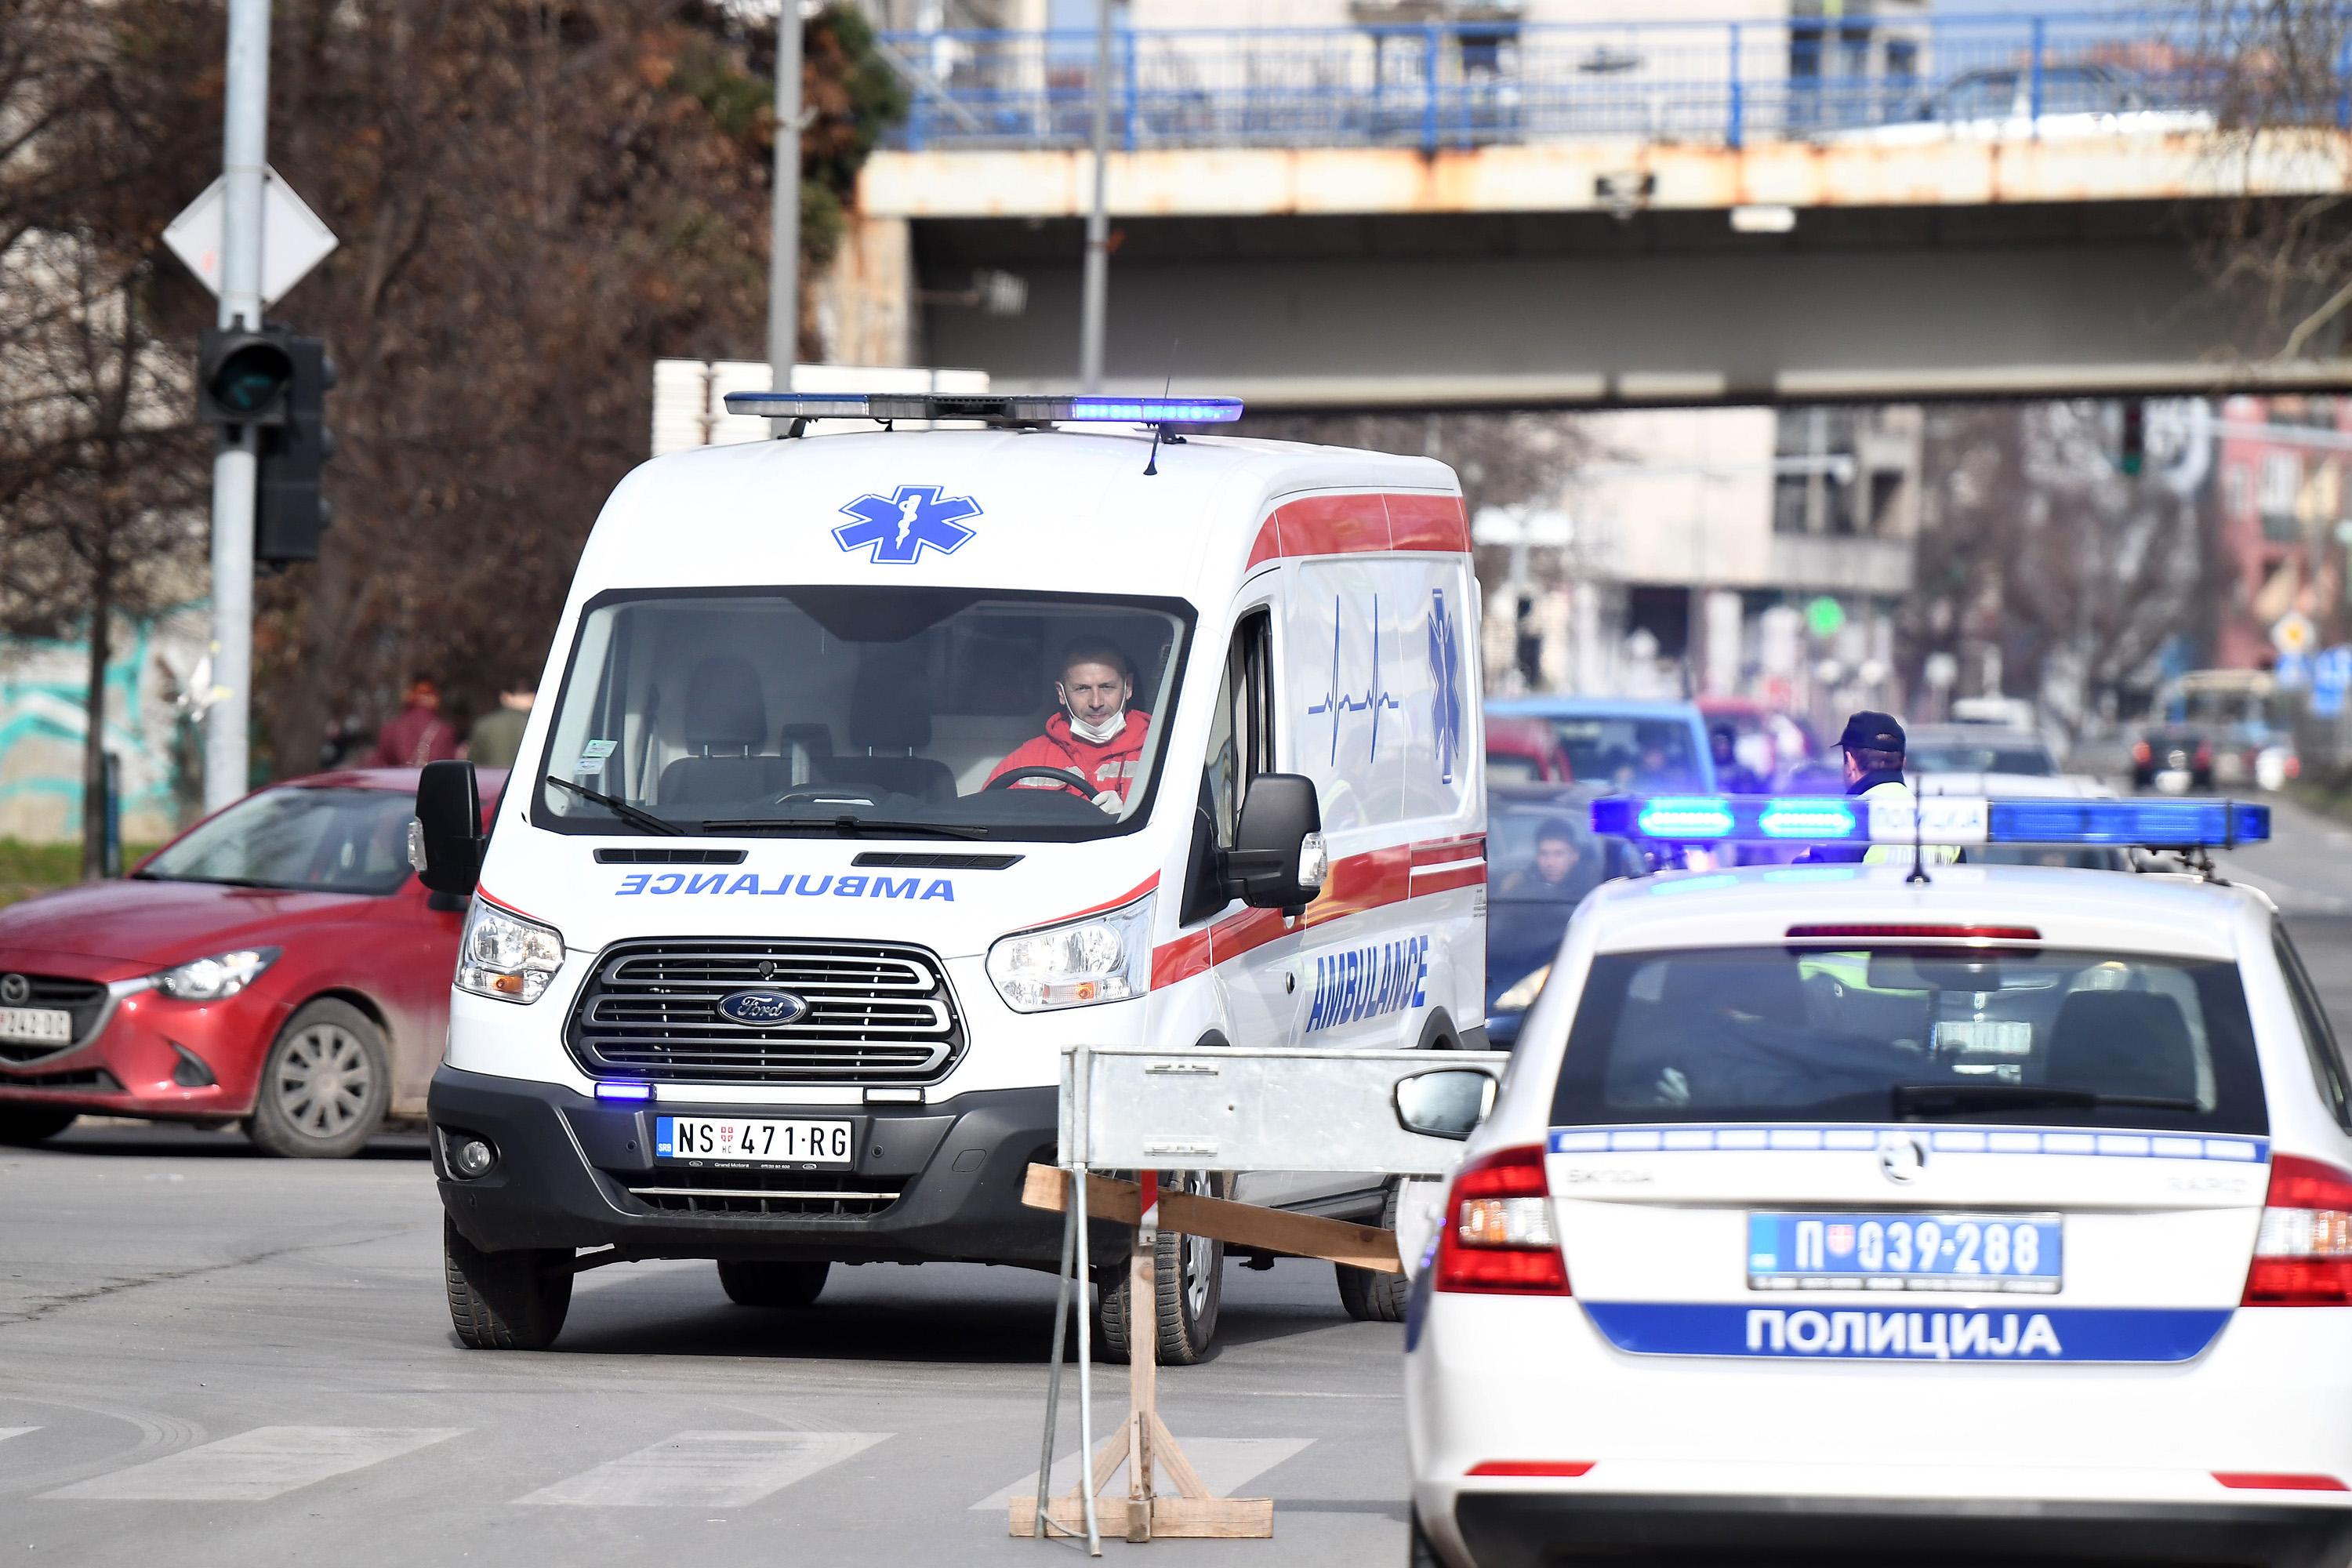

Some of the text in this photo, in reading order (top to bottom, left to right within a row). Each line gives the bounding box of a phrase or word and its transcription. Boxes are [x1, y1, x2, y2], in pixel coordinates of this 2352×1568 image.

[1305, 935, 1428, 1033] AMBULANCE
[737, 996, 784, 1017] Ford
[658, 1143, 672, 1152] SRB
[679, 1123, 713, 1153] NS
[1746, 1308, 2062, 1360] ПОЛИЦИЈА
